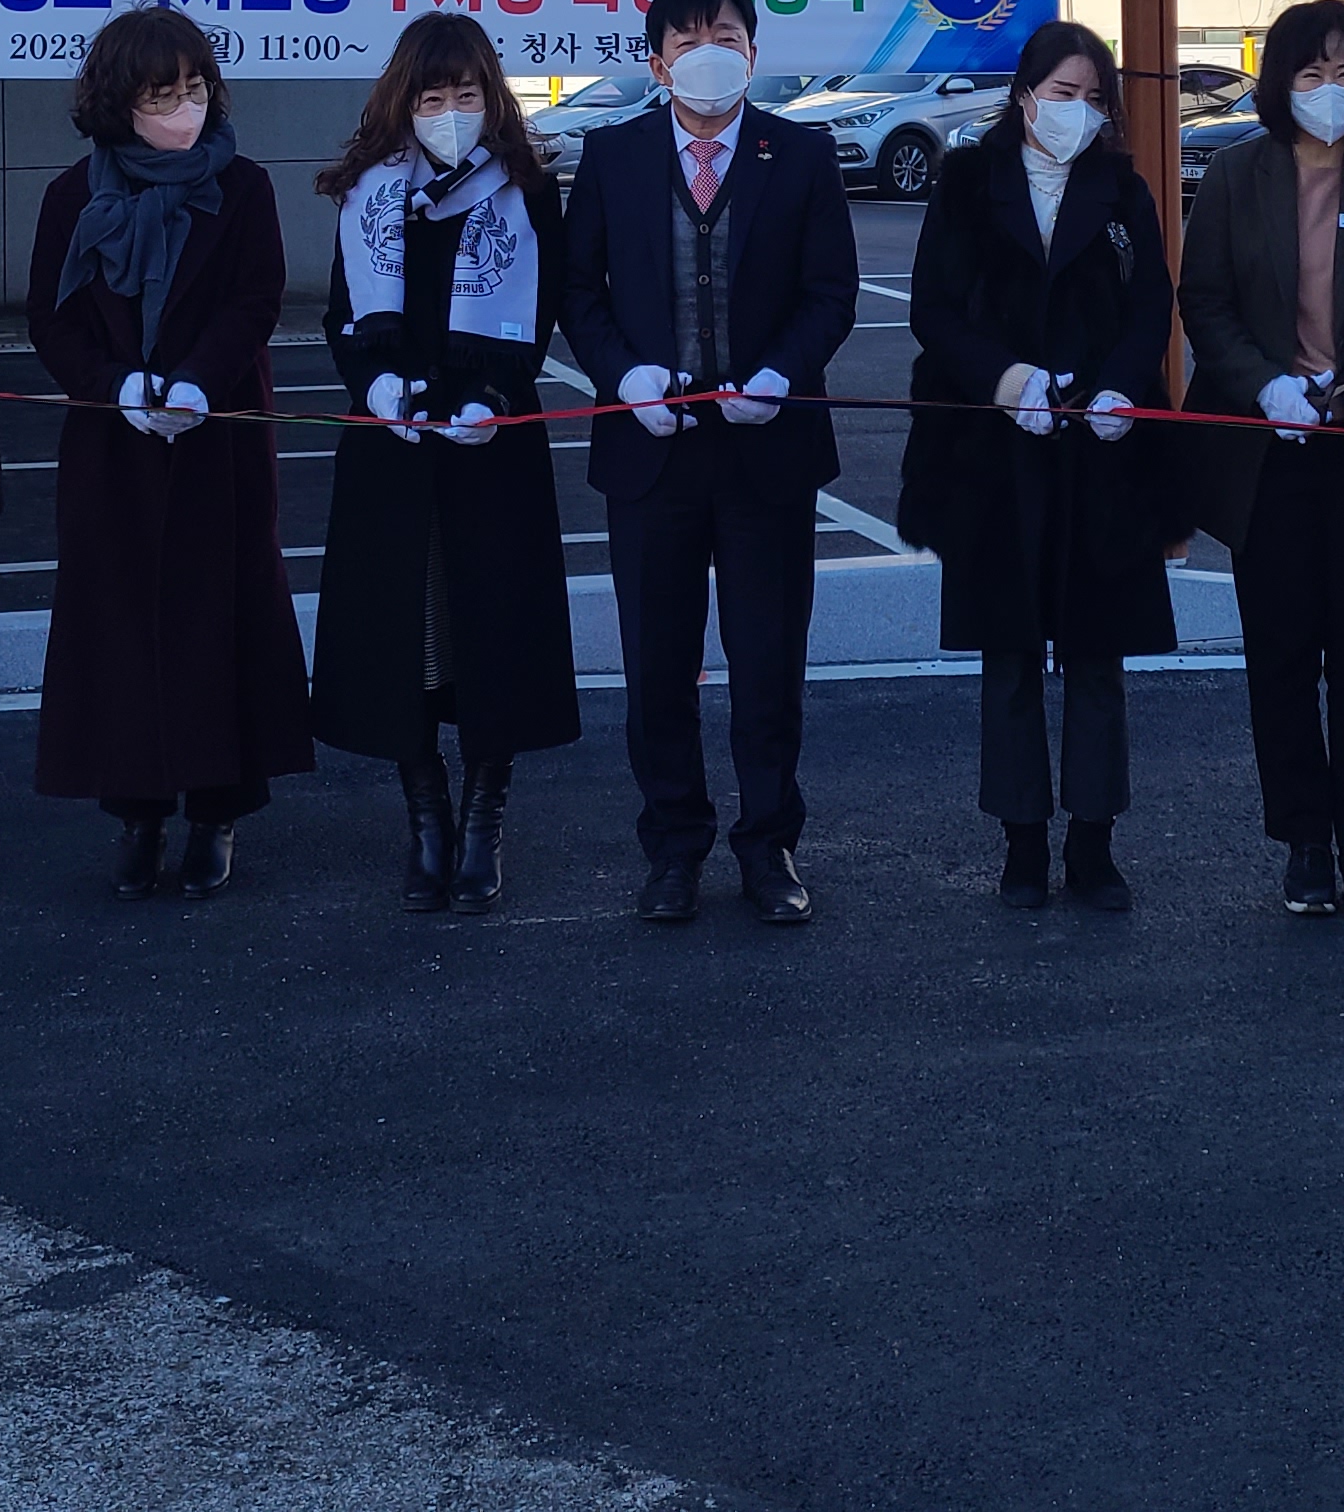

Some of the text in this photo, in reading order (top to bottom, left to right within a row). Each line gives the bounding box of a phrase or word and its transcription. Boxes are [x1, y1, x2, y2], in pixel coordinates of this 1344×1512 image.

[258, 34, 370, 61] 11:00~
[520, 32, 583, 64] 청사
[593, 32, 649, 65] 뒷편
